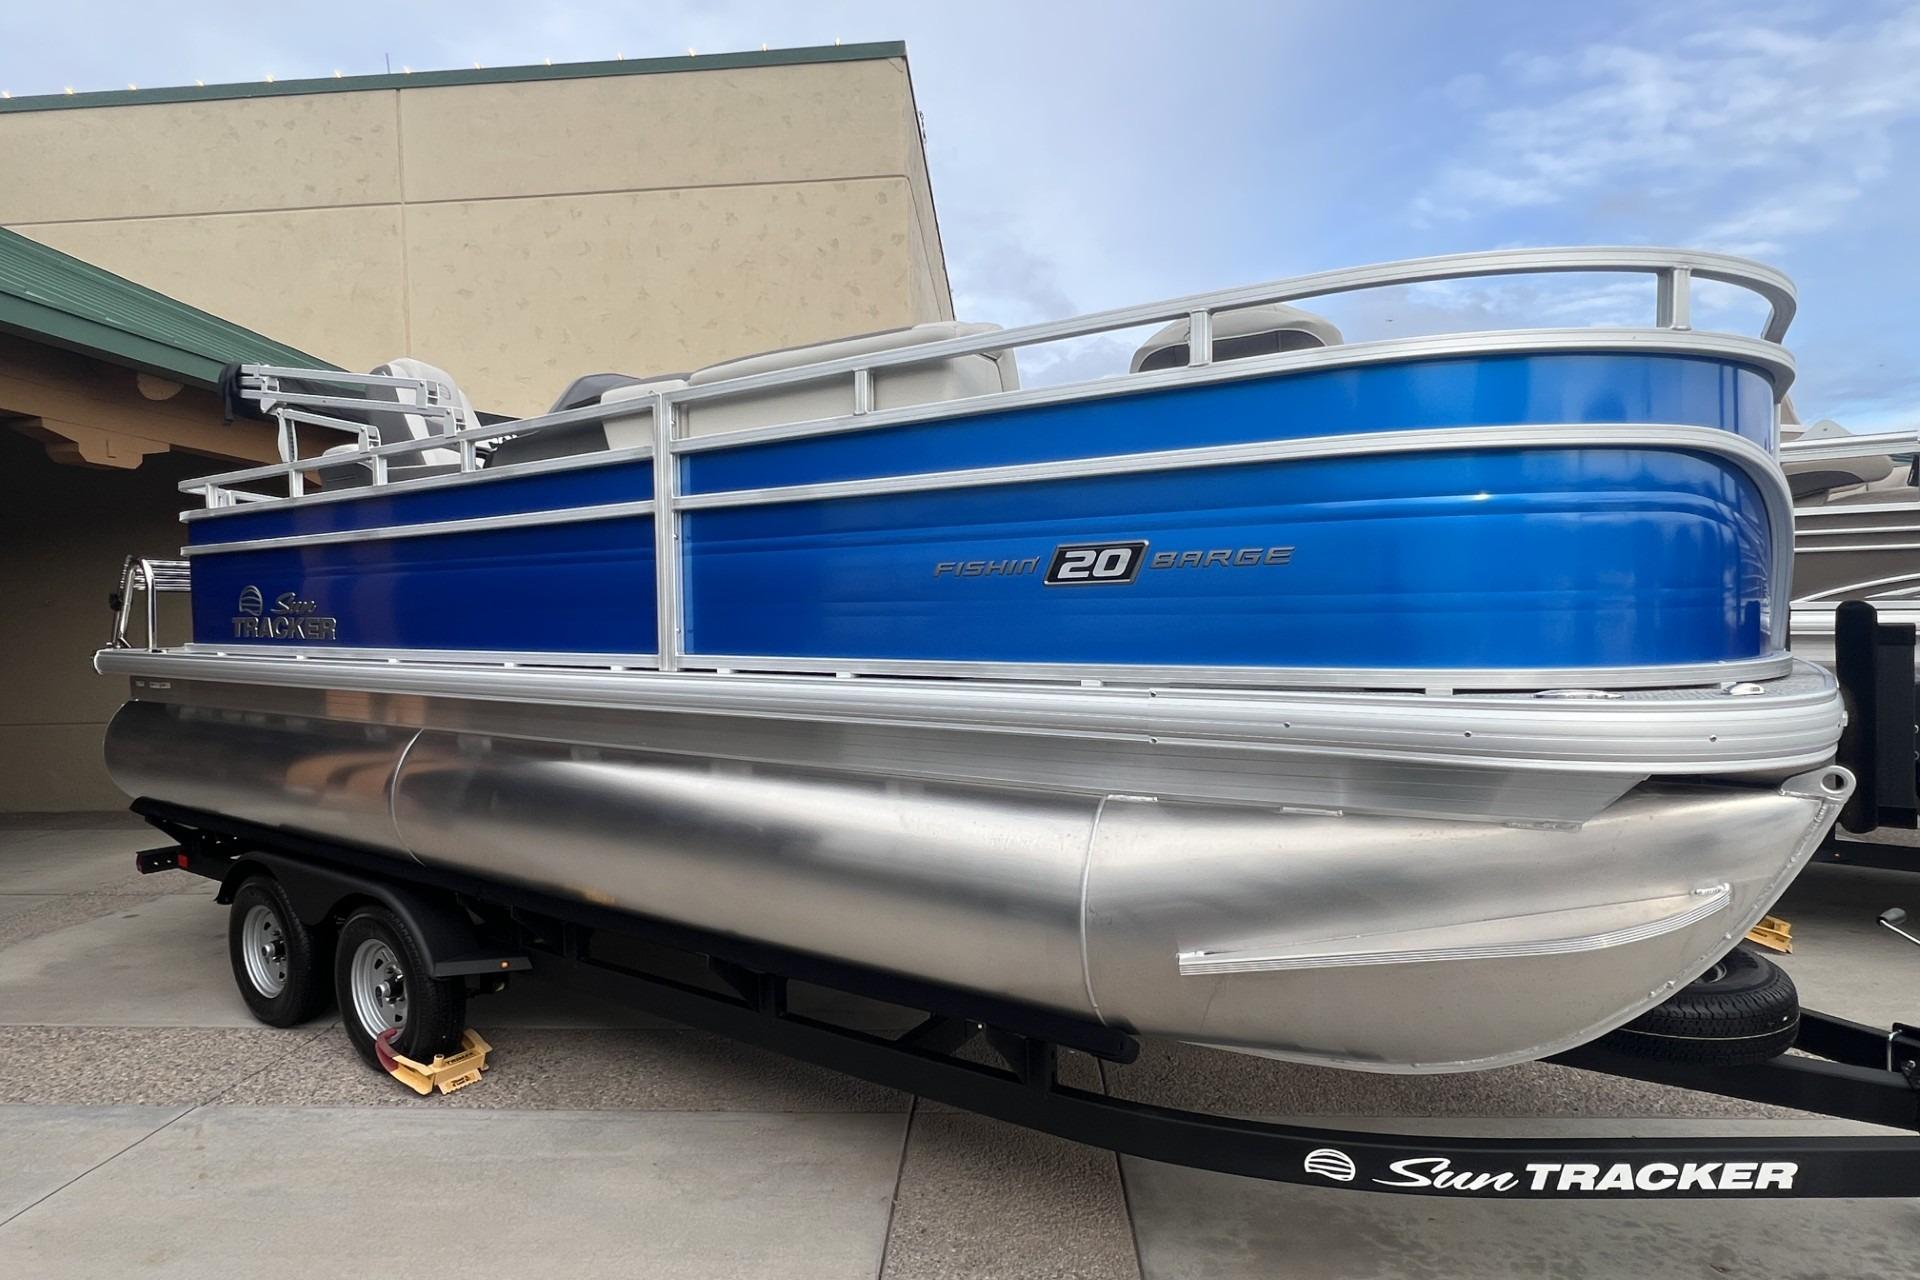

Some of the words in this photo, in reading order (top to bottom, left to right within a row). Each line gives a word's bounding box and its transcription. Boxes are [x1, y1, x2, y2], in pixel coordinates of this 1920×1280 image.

[1057, 549, 1132, 579] 20
[1151, 547, 1295, 568] BARGE
[270, 592, 317, 614] Sun
[232, 617, 337, 640] TRACKER
[1372, 1157, 1520, 1191] Sun
[1525, 1162, 1799, 1191] TRACKER
